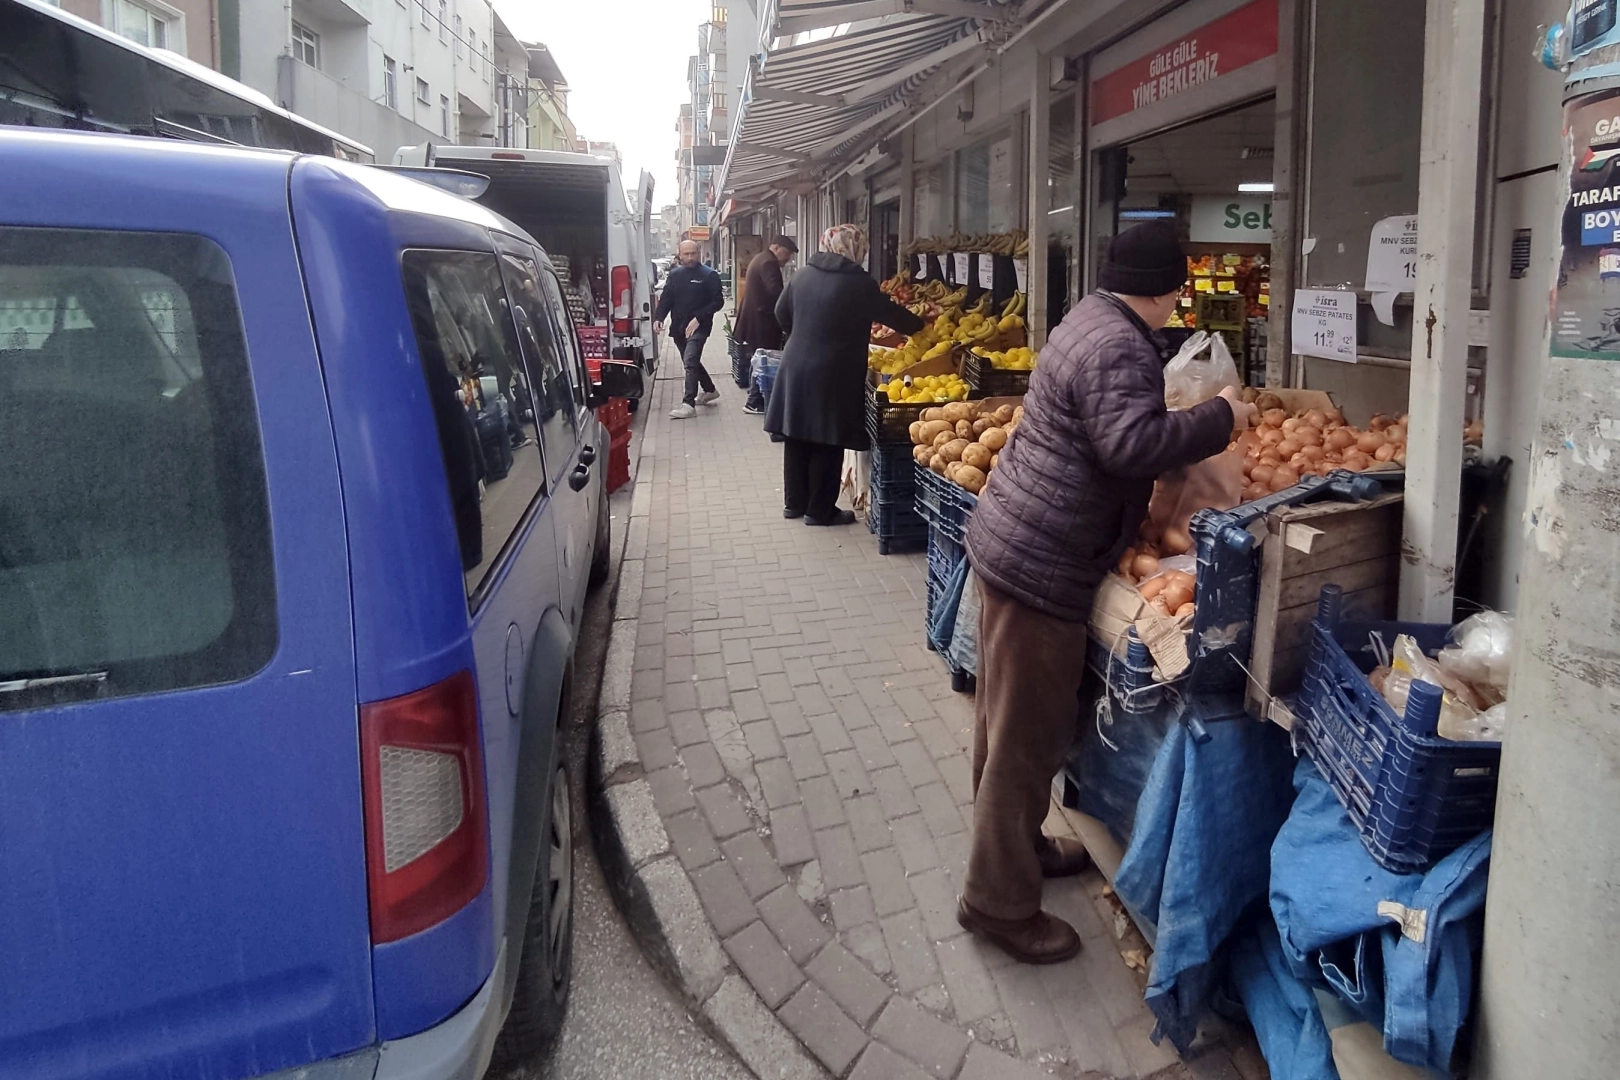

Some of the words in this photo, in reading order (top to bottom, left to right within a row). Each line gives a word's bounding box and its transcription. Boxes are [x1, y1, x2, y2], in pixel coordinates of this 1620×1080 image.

[1150, 53, 1171, 78] GÜLE
[1173, 39, 1197, 67] GÜLE
[1132, 81, 1157, 110] YİNE
[1159, 51, 1218, 99] BEKLERİZ
[1381, 237, 1399, 245] MNV
[1308, 309, 1327, 318] SEBZE
[1328, 311, 1353, 321] PATATES
